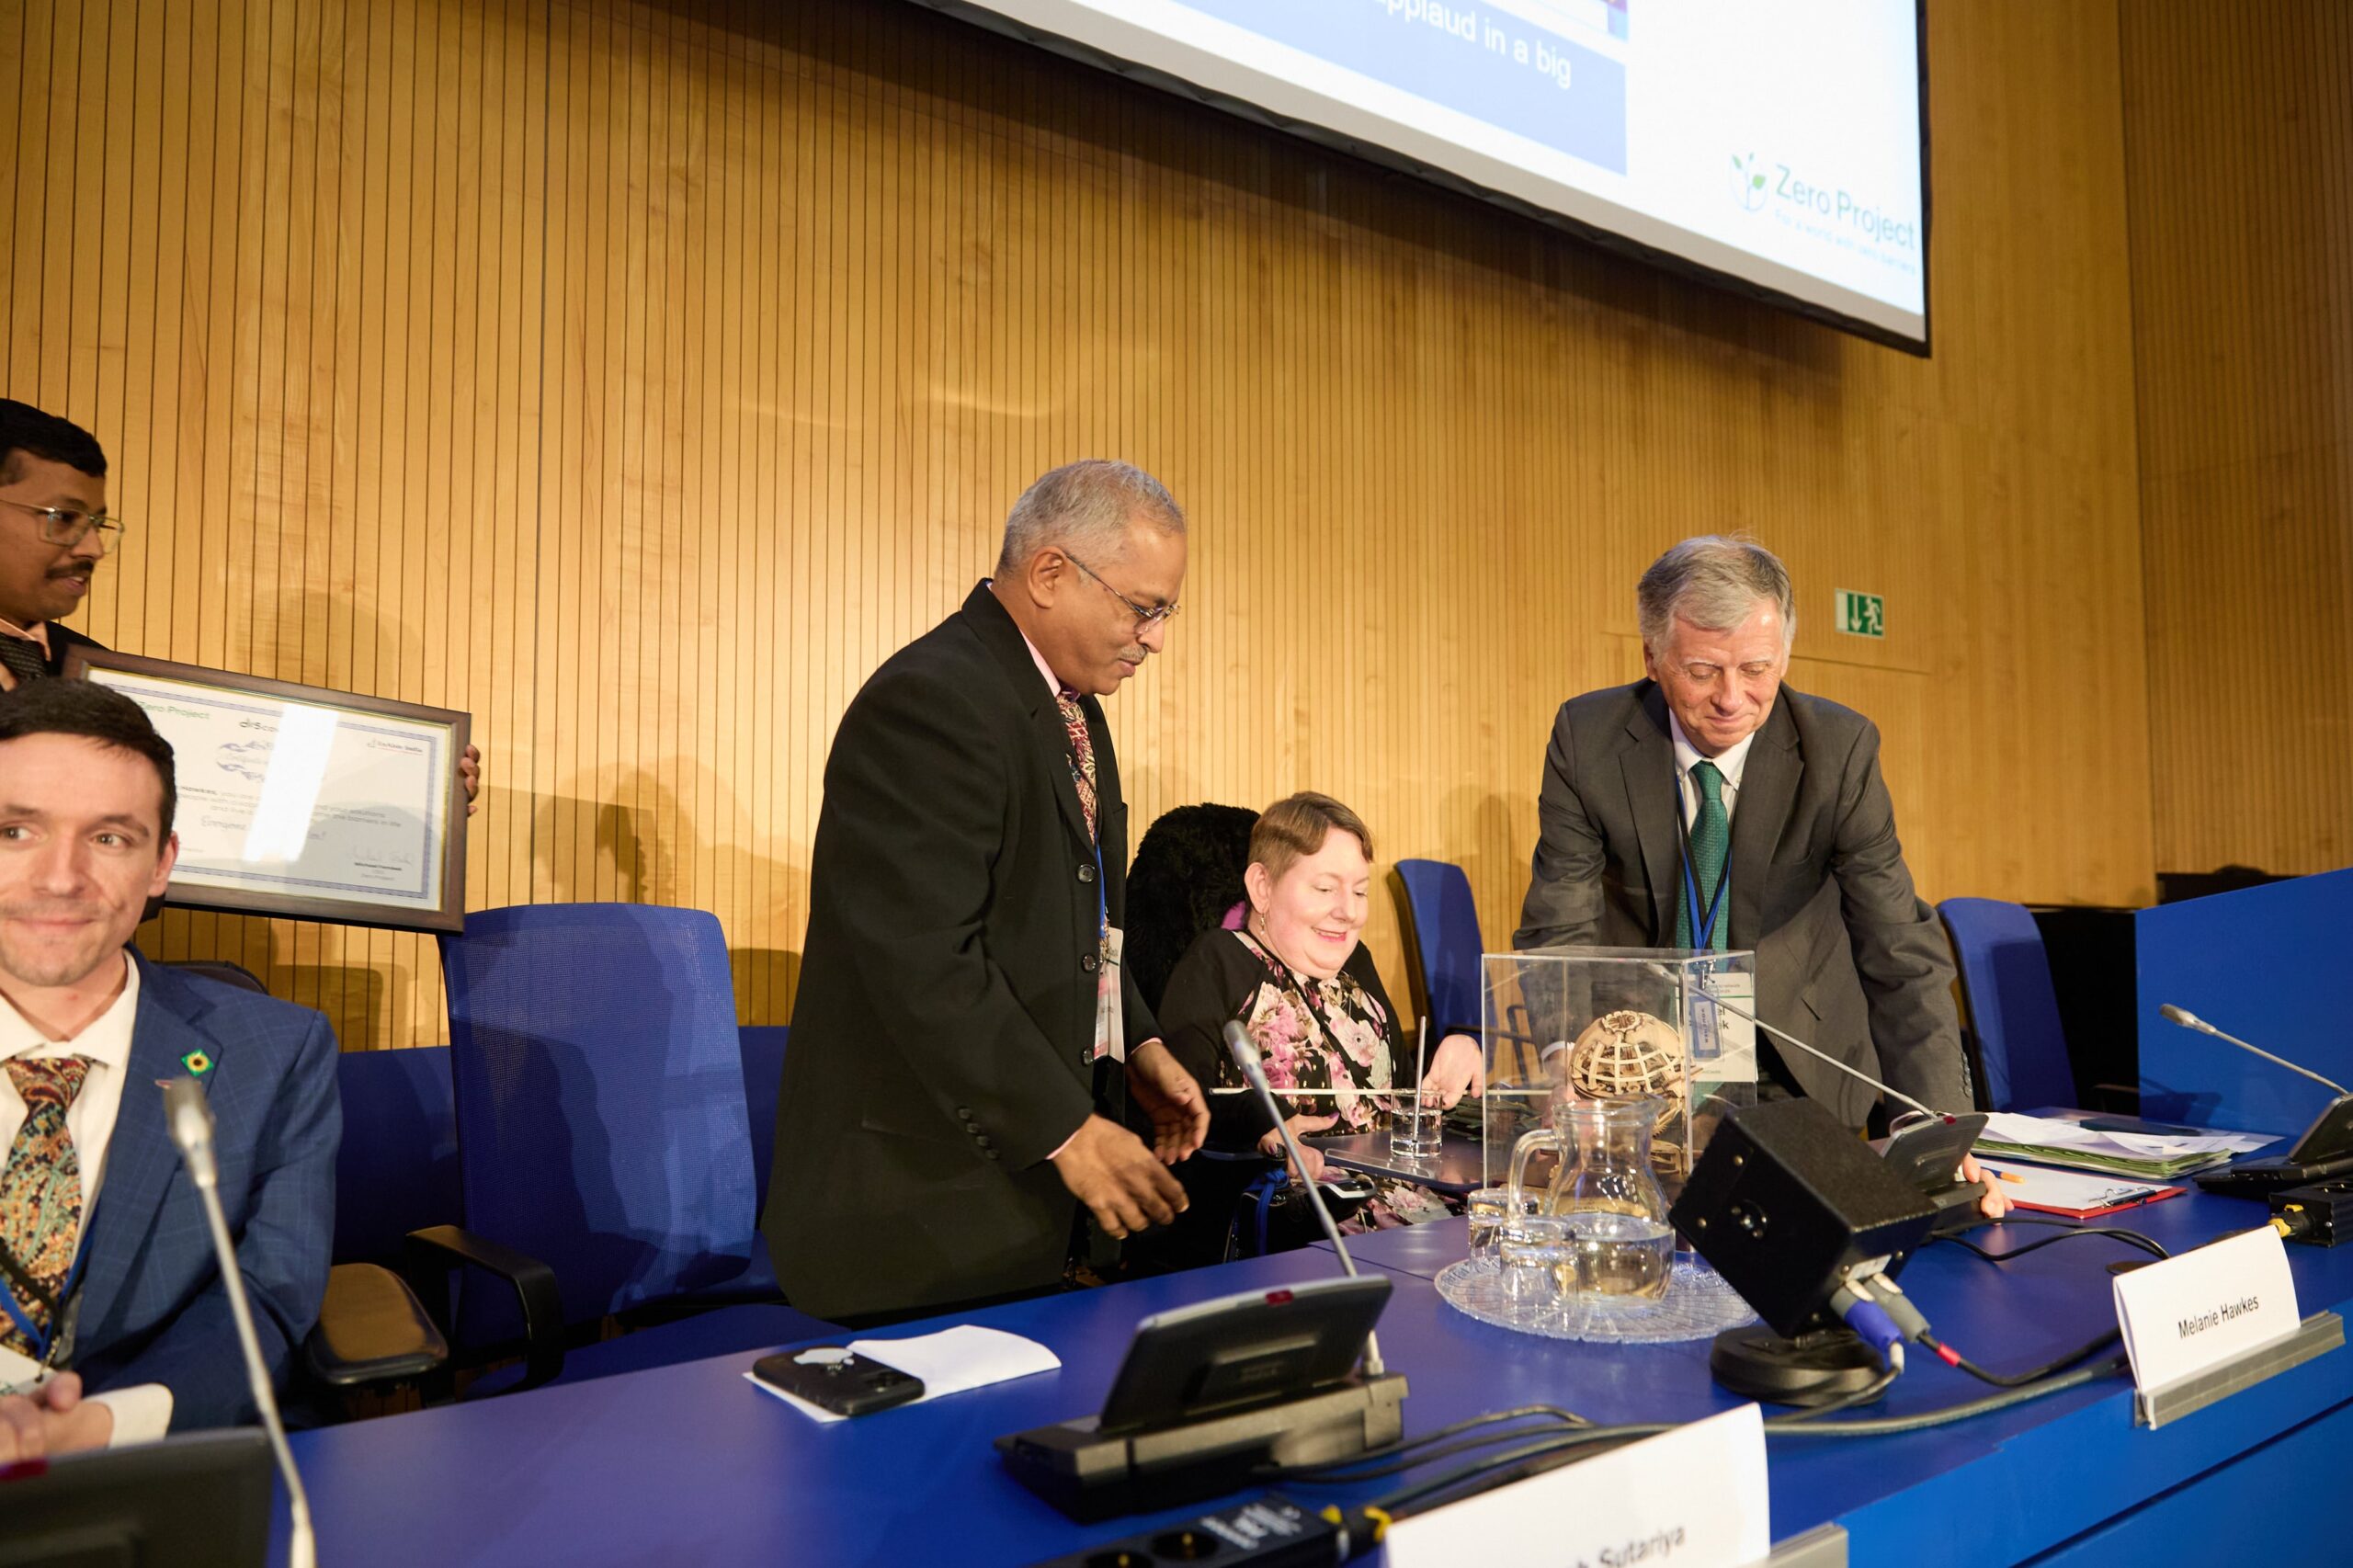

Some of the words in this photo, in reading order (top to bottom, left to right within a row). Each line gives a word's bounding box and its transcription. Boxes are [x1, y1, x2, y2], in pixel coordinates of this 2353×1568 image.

[1374, 0, 1477, 43] pplaud
[1484, 17, 1506, 56] in
[1513, 38, 1529, 65] a
[1535, 40, 1572, 90] big
[1775, 163, 1831, 215] Zero
[1836, 187, 1916, 250] Project
[167, 705, 210, 720] Project
[2177, 1309, 2219, 1339] Melanie
[2221, 1295, 2259, 1323] Hawkes
[1599, 1526, 1686, 1568] Sutariya
